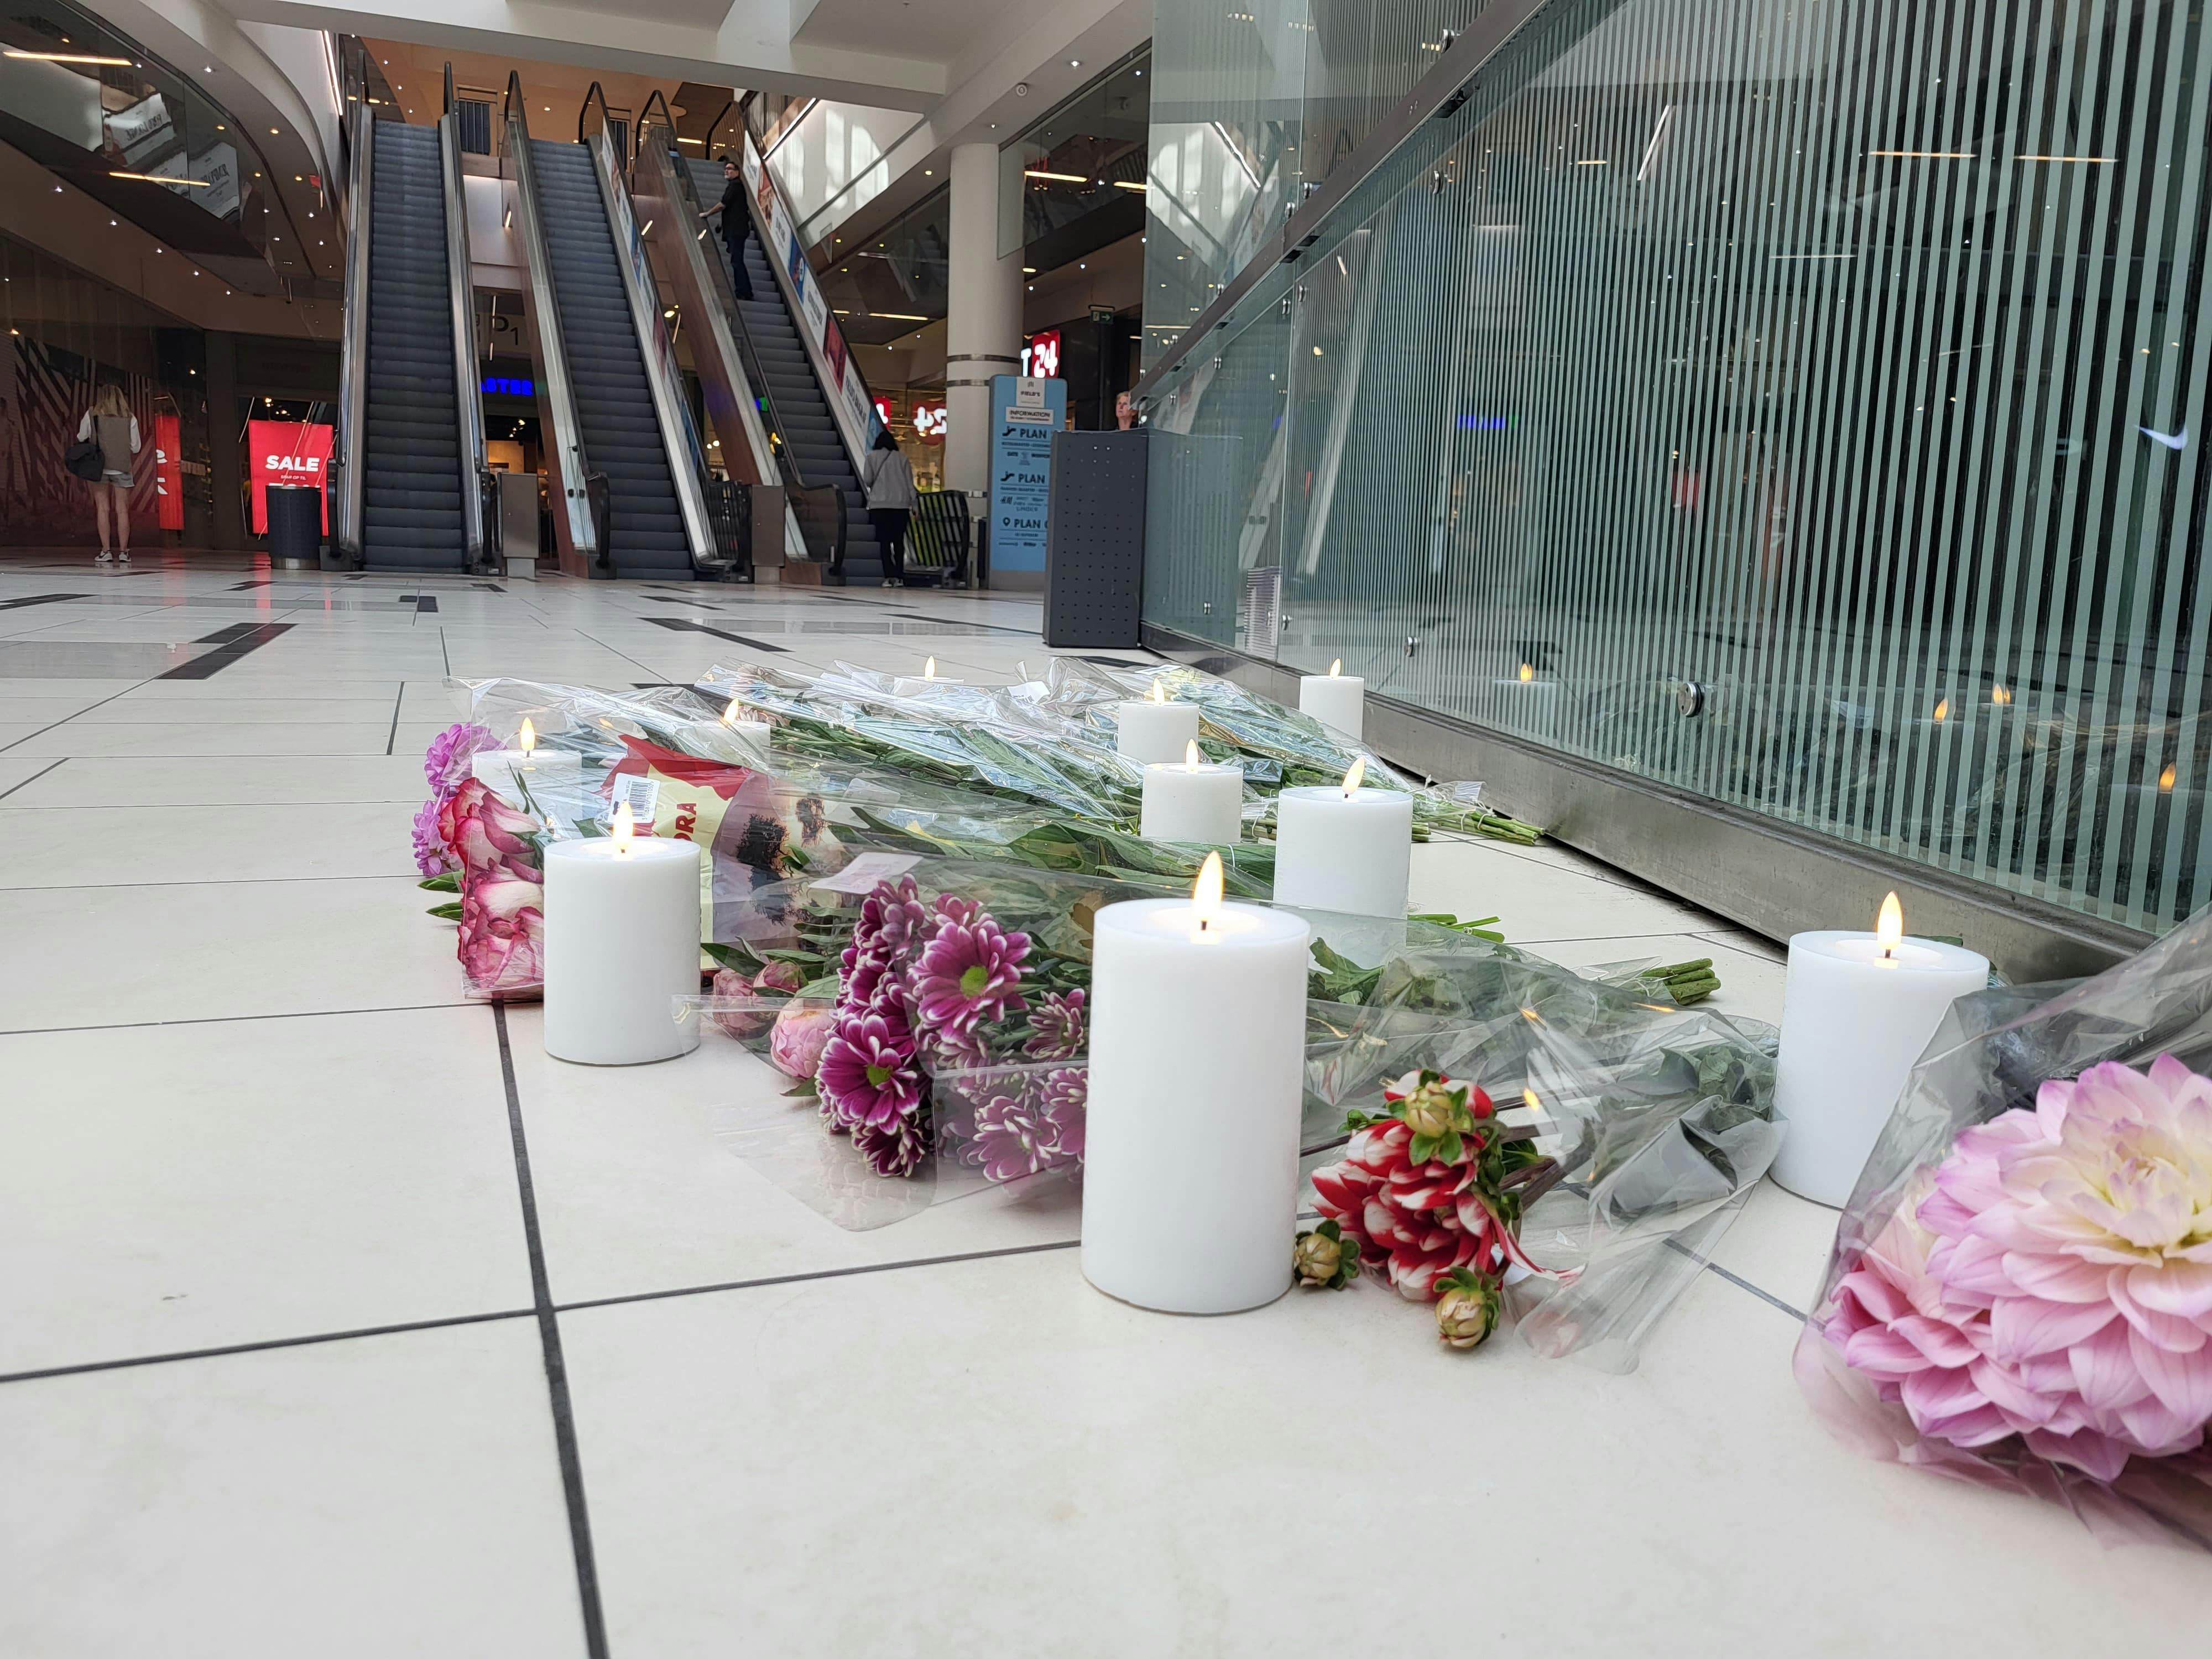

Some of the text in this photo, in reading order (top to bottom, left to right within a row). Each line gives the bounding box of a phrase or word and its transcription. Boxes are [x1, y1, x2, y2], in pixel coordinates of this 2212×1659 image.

[1034, 340, 1058, 378] 24
[1020, 429, 1047, 440] PLAN
[265, 455, 320, 472] SALE
[1018, 473, 1046, 484] PLAN
[1014, 519, 1041, 529] PLAN
